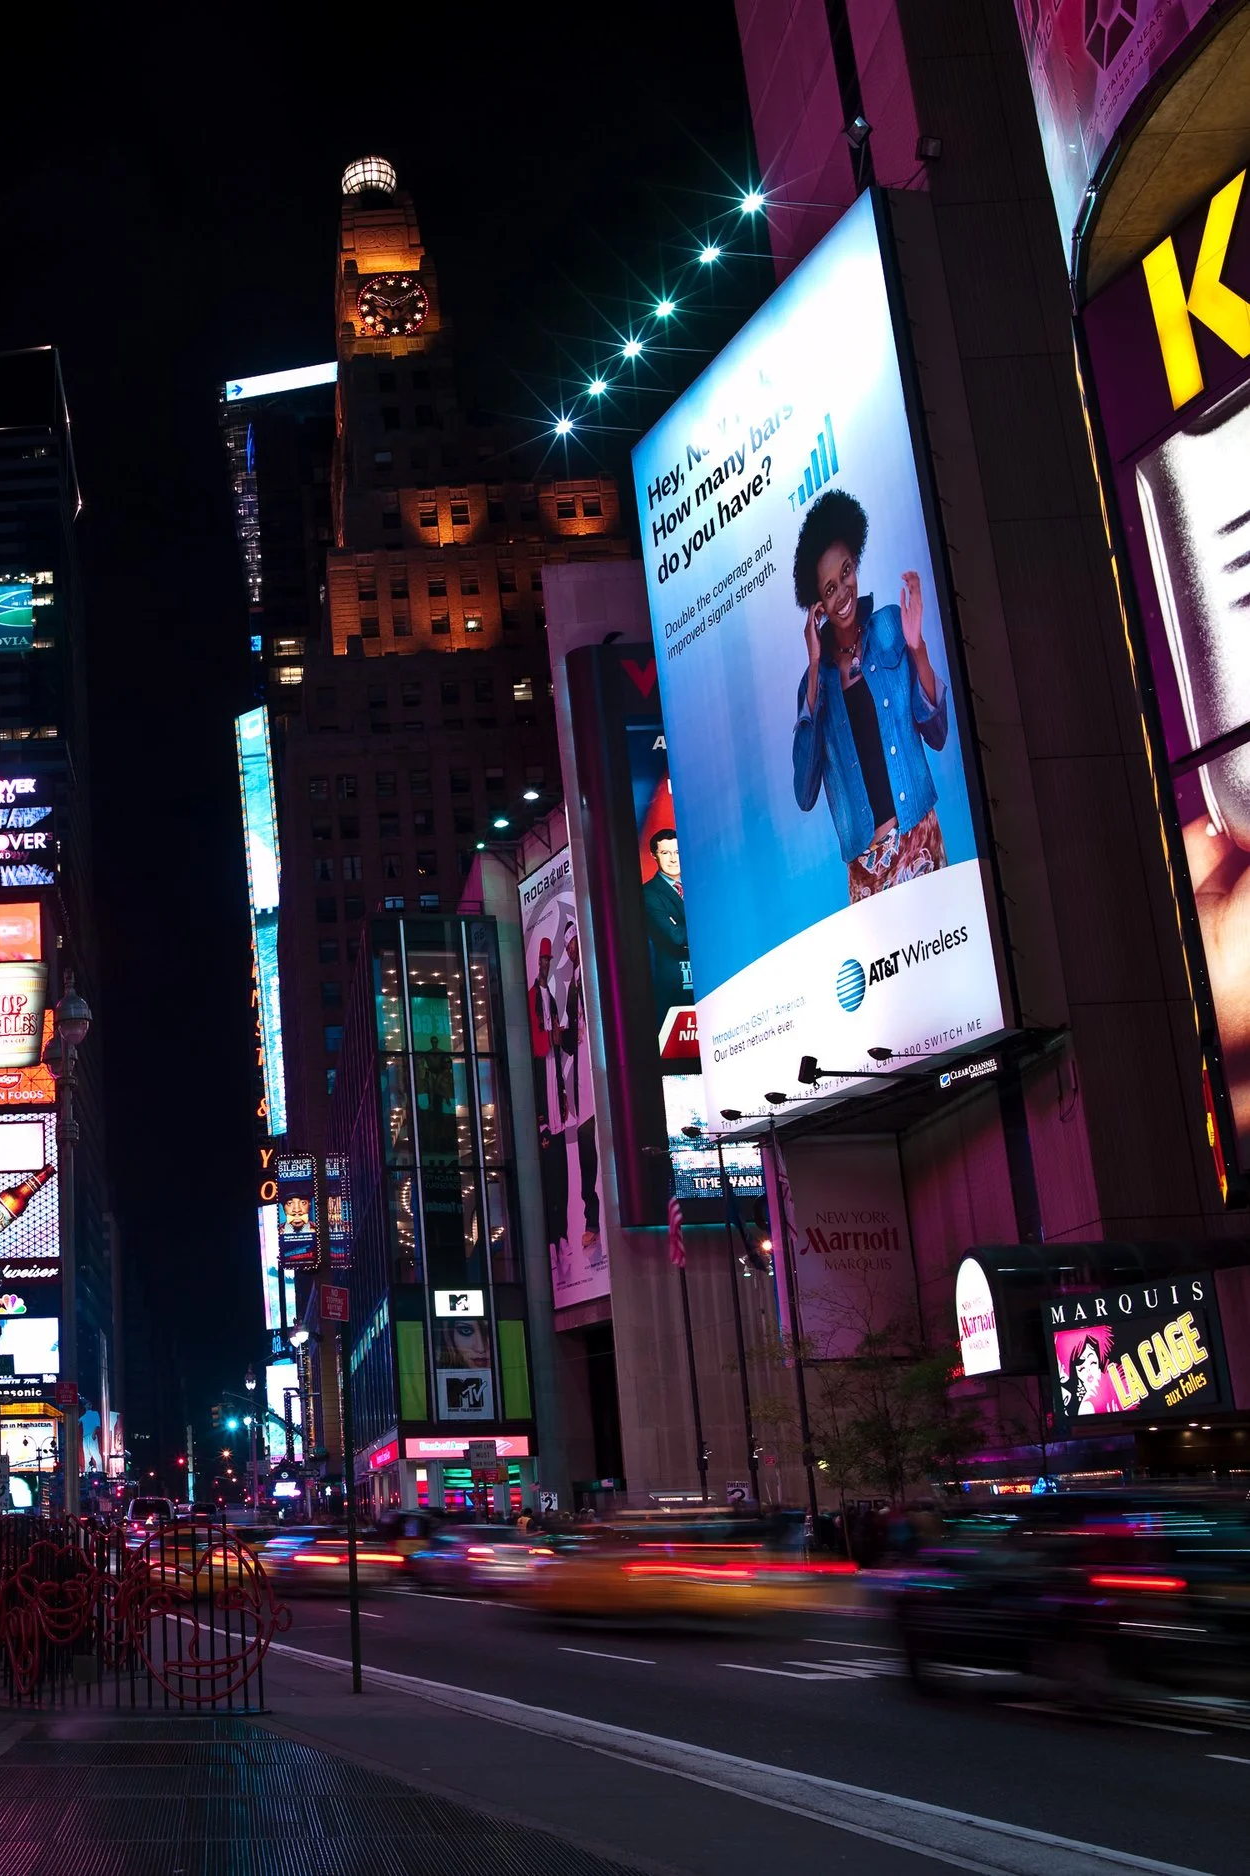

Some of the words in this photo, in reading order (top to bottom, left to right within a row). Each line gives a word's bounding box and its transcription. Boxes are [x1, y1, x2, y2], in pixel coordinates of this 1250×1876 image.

[1142, 169, 1250, 411] K
[647, 463, 686, 511] Hey,
[652, 494, 692, 548] How
[695, 441, 747, 508] many
[749, 404, 794, 453] bars
[657, 552, 680, 586] do
[682, 517, 716, 569] you
[717, 455, 773, 531] have?
[664, 605, 696, 640] Double
[696, 594, 711, 613] the
[713, 557, 754, 599] coverage
[754, 535, 773, 565] and
[667, 622, 706, 660] improved
[707, 598, 734, 634] signal
[735, 561, 777, 604] strength.
[868, 950, 901, 986] AT&T
[901, 925, 969, 968] Wireless
[713, 1049, 728, 1063] Our
[729, 1039, 746, 1056] best
[746, 1025, 776, 1048] network
[777, 1019, 795, 1035] ever.
[924, 1026, 963, 1050] SWITCH
[967, 1018, 983, 1034] ME
[8, 1089, 44, 1100] FOODS
[278, 1163, 312, 1172] SILENCE
[278, 1169, 312, 1178] YOURSELF
[693, 1177, 722, 1189] TIME
[815, 1210, 849, 1224] NEW
[851, 1210, 890, 1224] YORK
[799, 1226, 901, 1256] Marriott
[824, 1258, 892, 1272] MARQUIS
[1050, 1280, 1206, 1325] MARQUIS
[1108, 1352, 1142, 1410] LA
[1140, 1311, 1209, 1390] CAGE
[445, 1377, 488, 1408] MTV
[1164, 1389, 1182, 1408] aux
[1179, 1372, 1208, 1401] Folles
